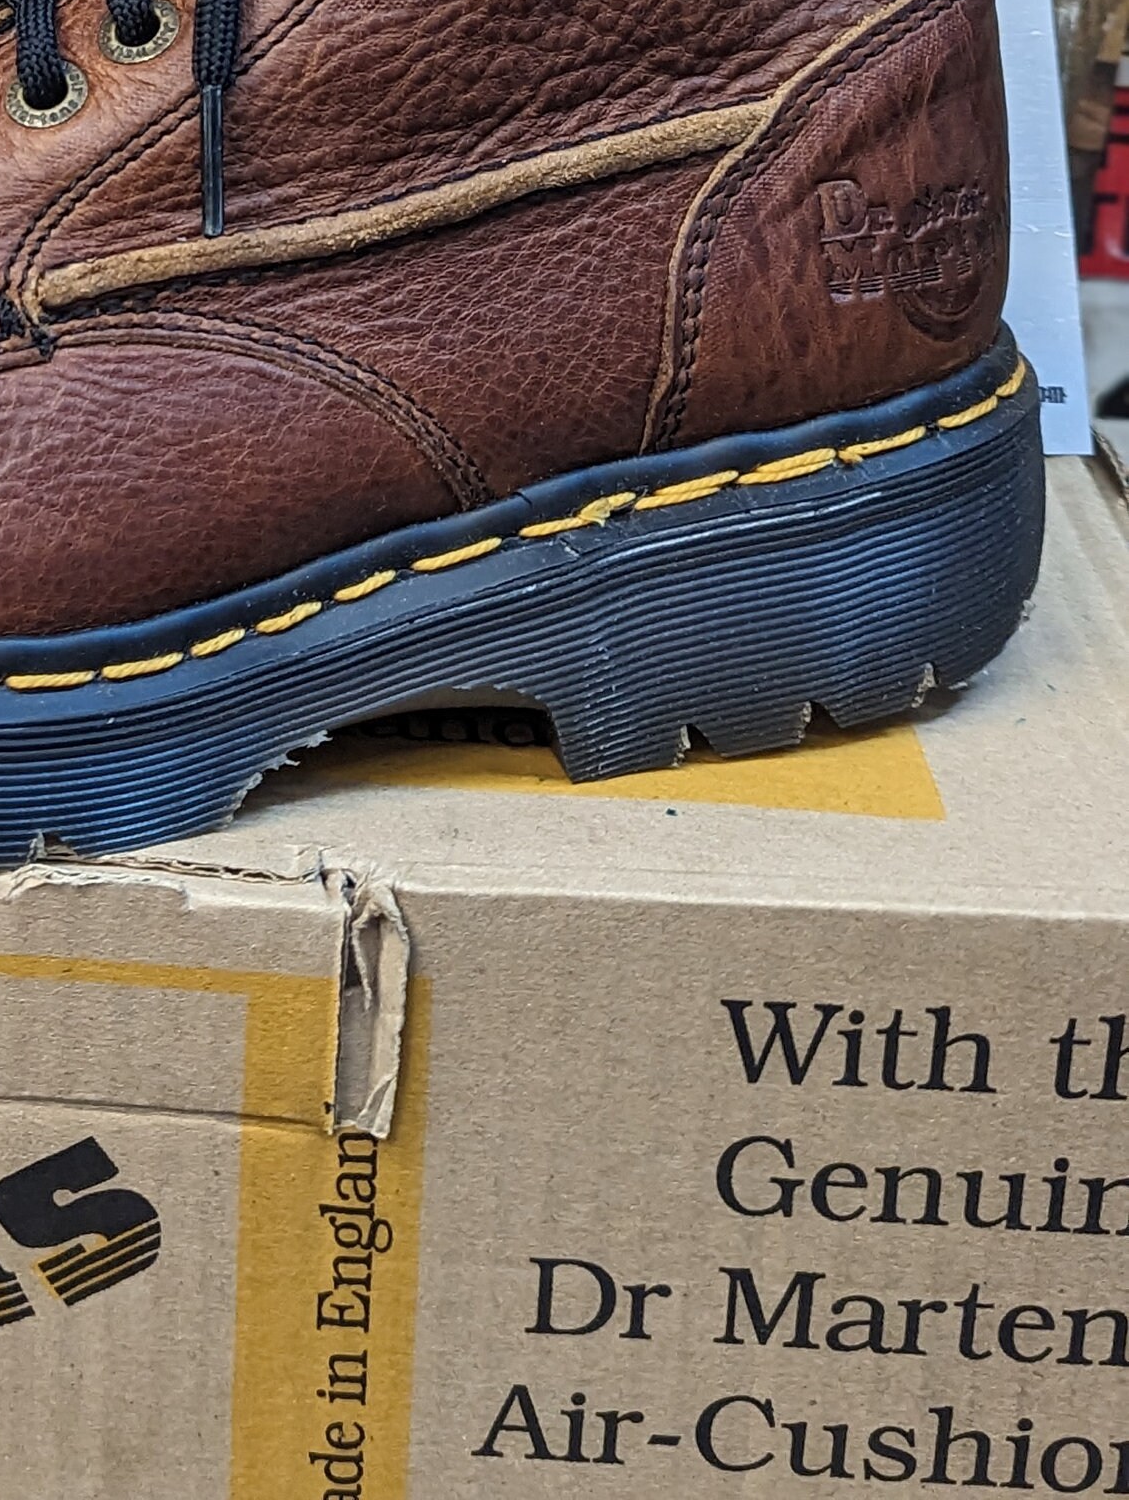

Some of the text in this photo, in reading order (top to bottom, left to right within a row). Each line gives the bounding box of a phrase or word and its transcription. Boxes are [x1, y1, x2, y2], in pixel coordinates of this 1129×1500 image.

[720, 999, 997, 1094] With
[716, 1135, 1129, 1236] Genuin
[309, 1130, 394, 1500] ade in Englan
[524, 1257, 1129, 1367] Dr Marten
